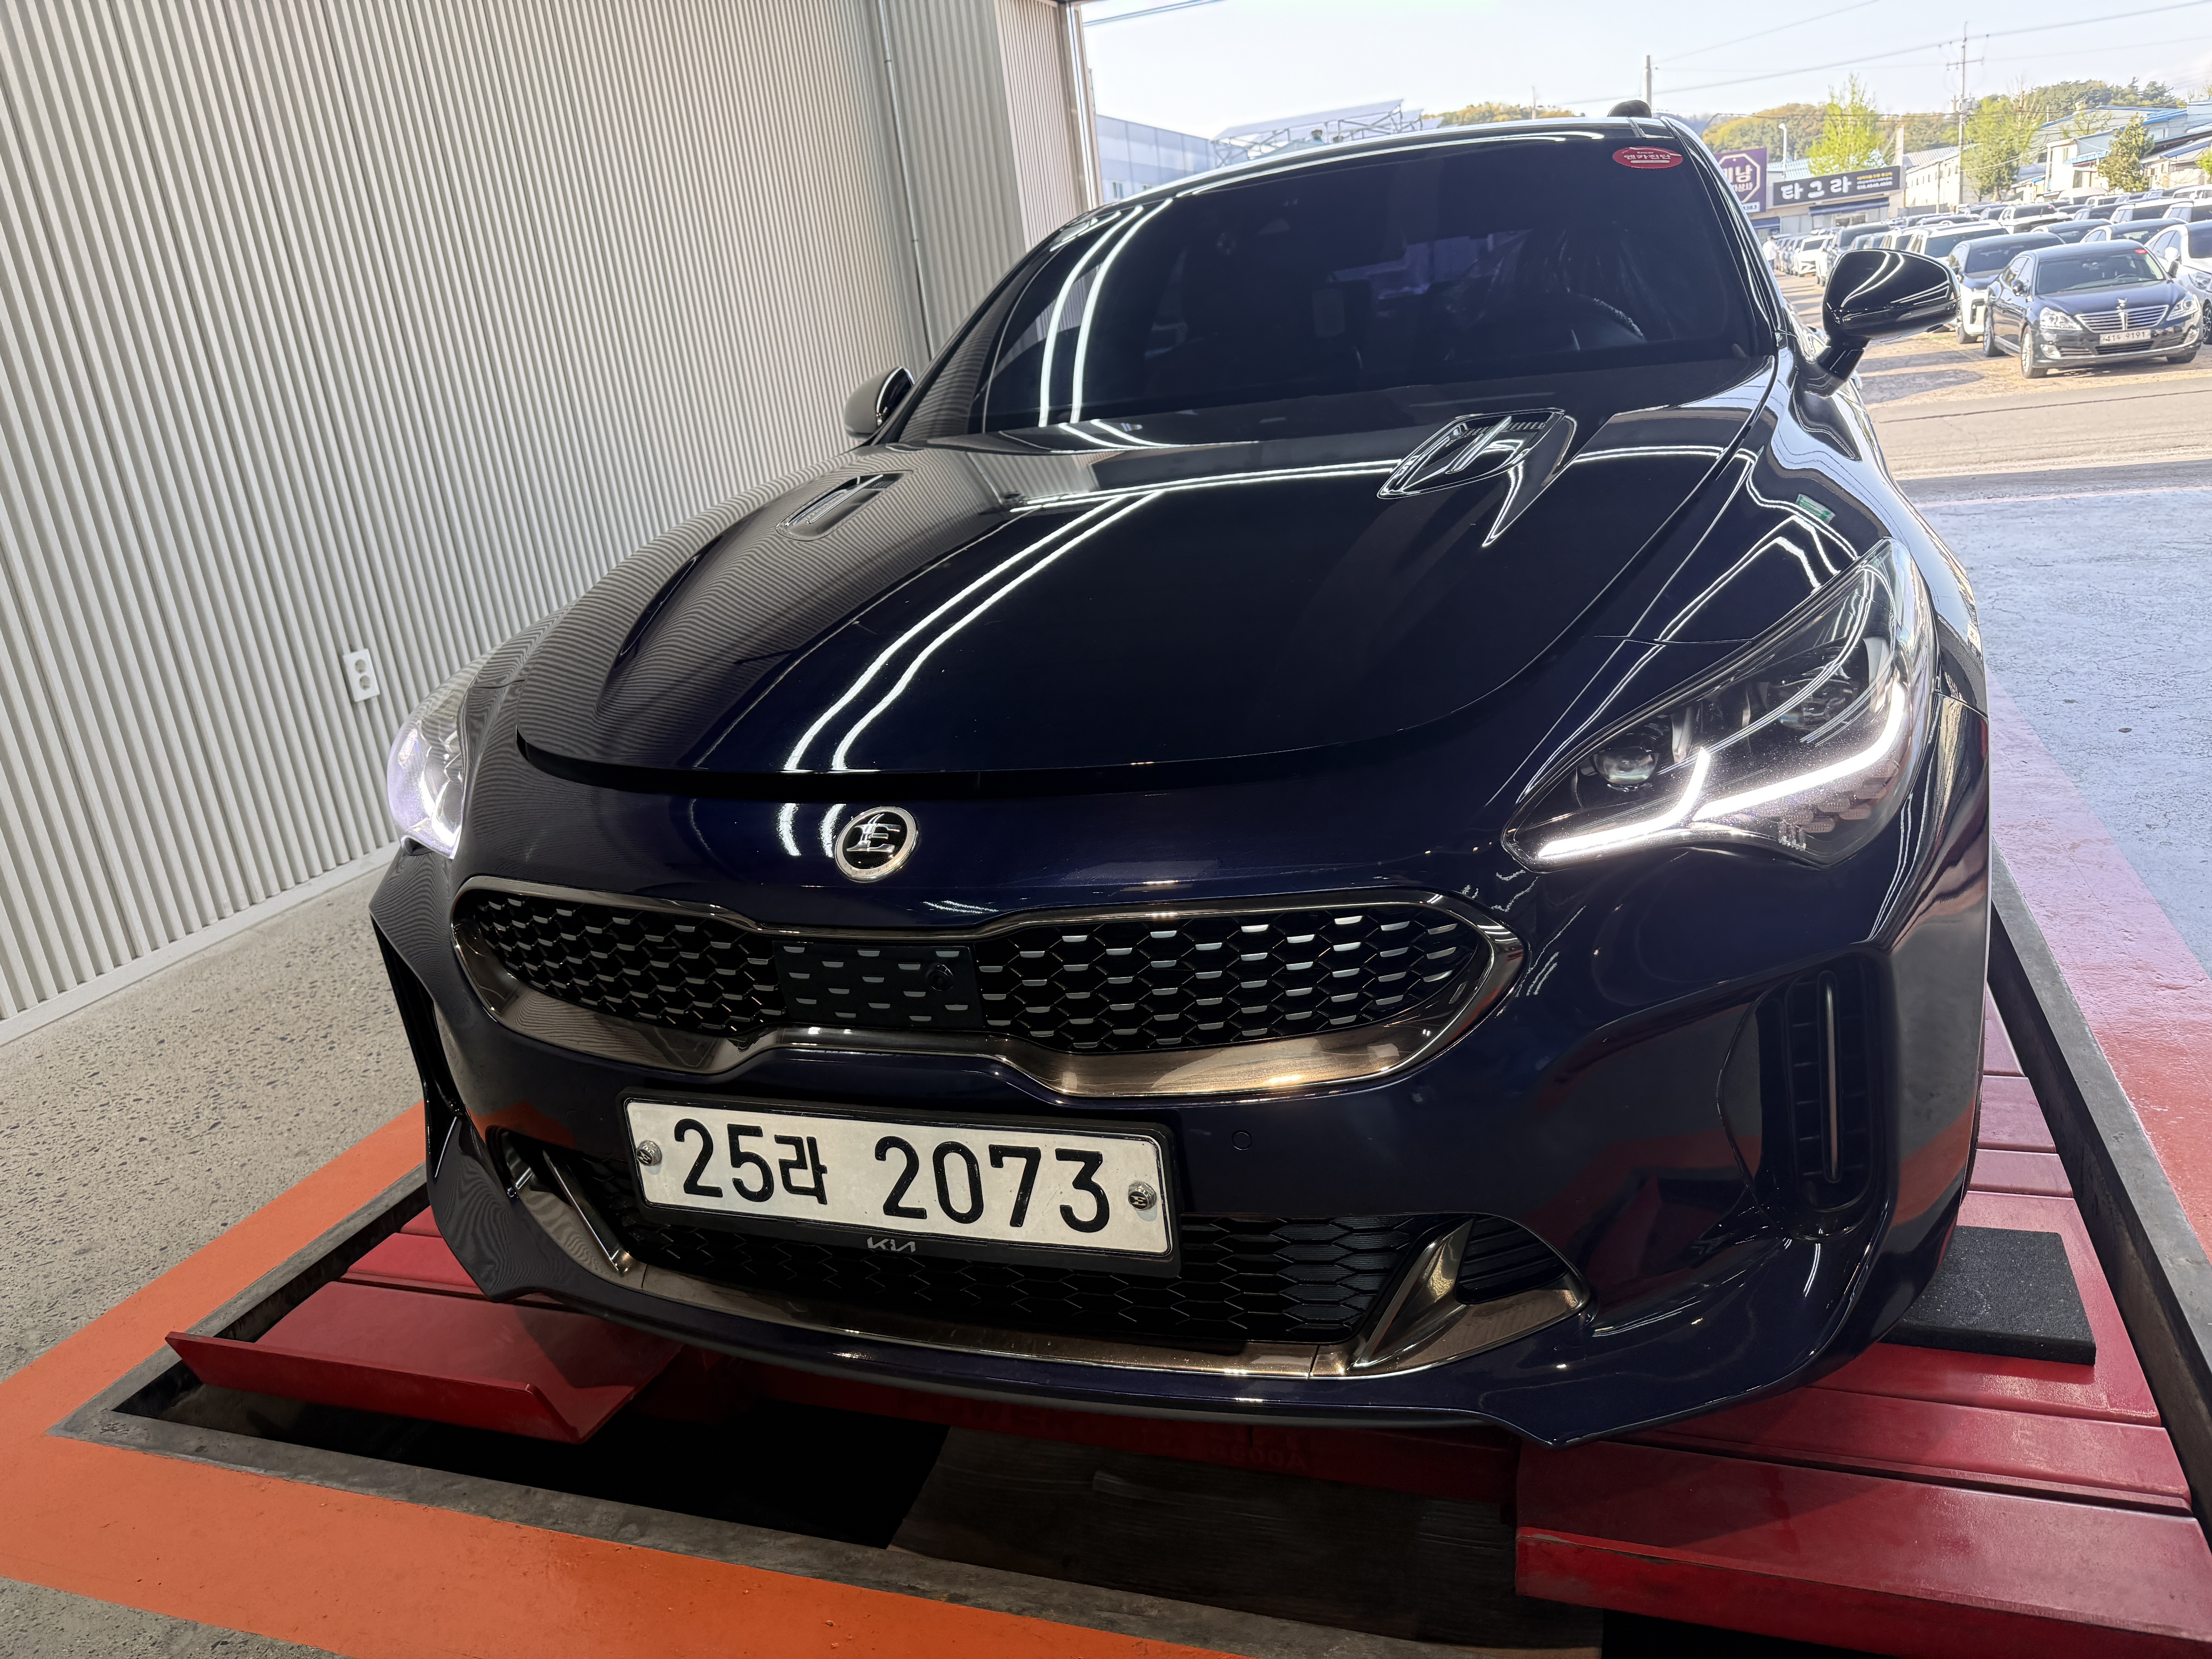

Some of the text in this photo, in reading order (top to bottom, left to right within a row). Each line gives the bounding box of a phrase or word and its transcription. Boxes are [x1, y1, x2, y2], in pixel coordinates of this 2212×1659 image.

[1781, 176, 1852, 199] 타그라
[674, 1119, 1109, 1233] 25라 2073
